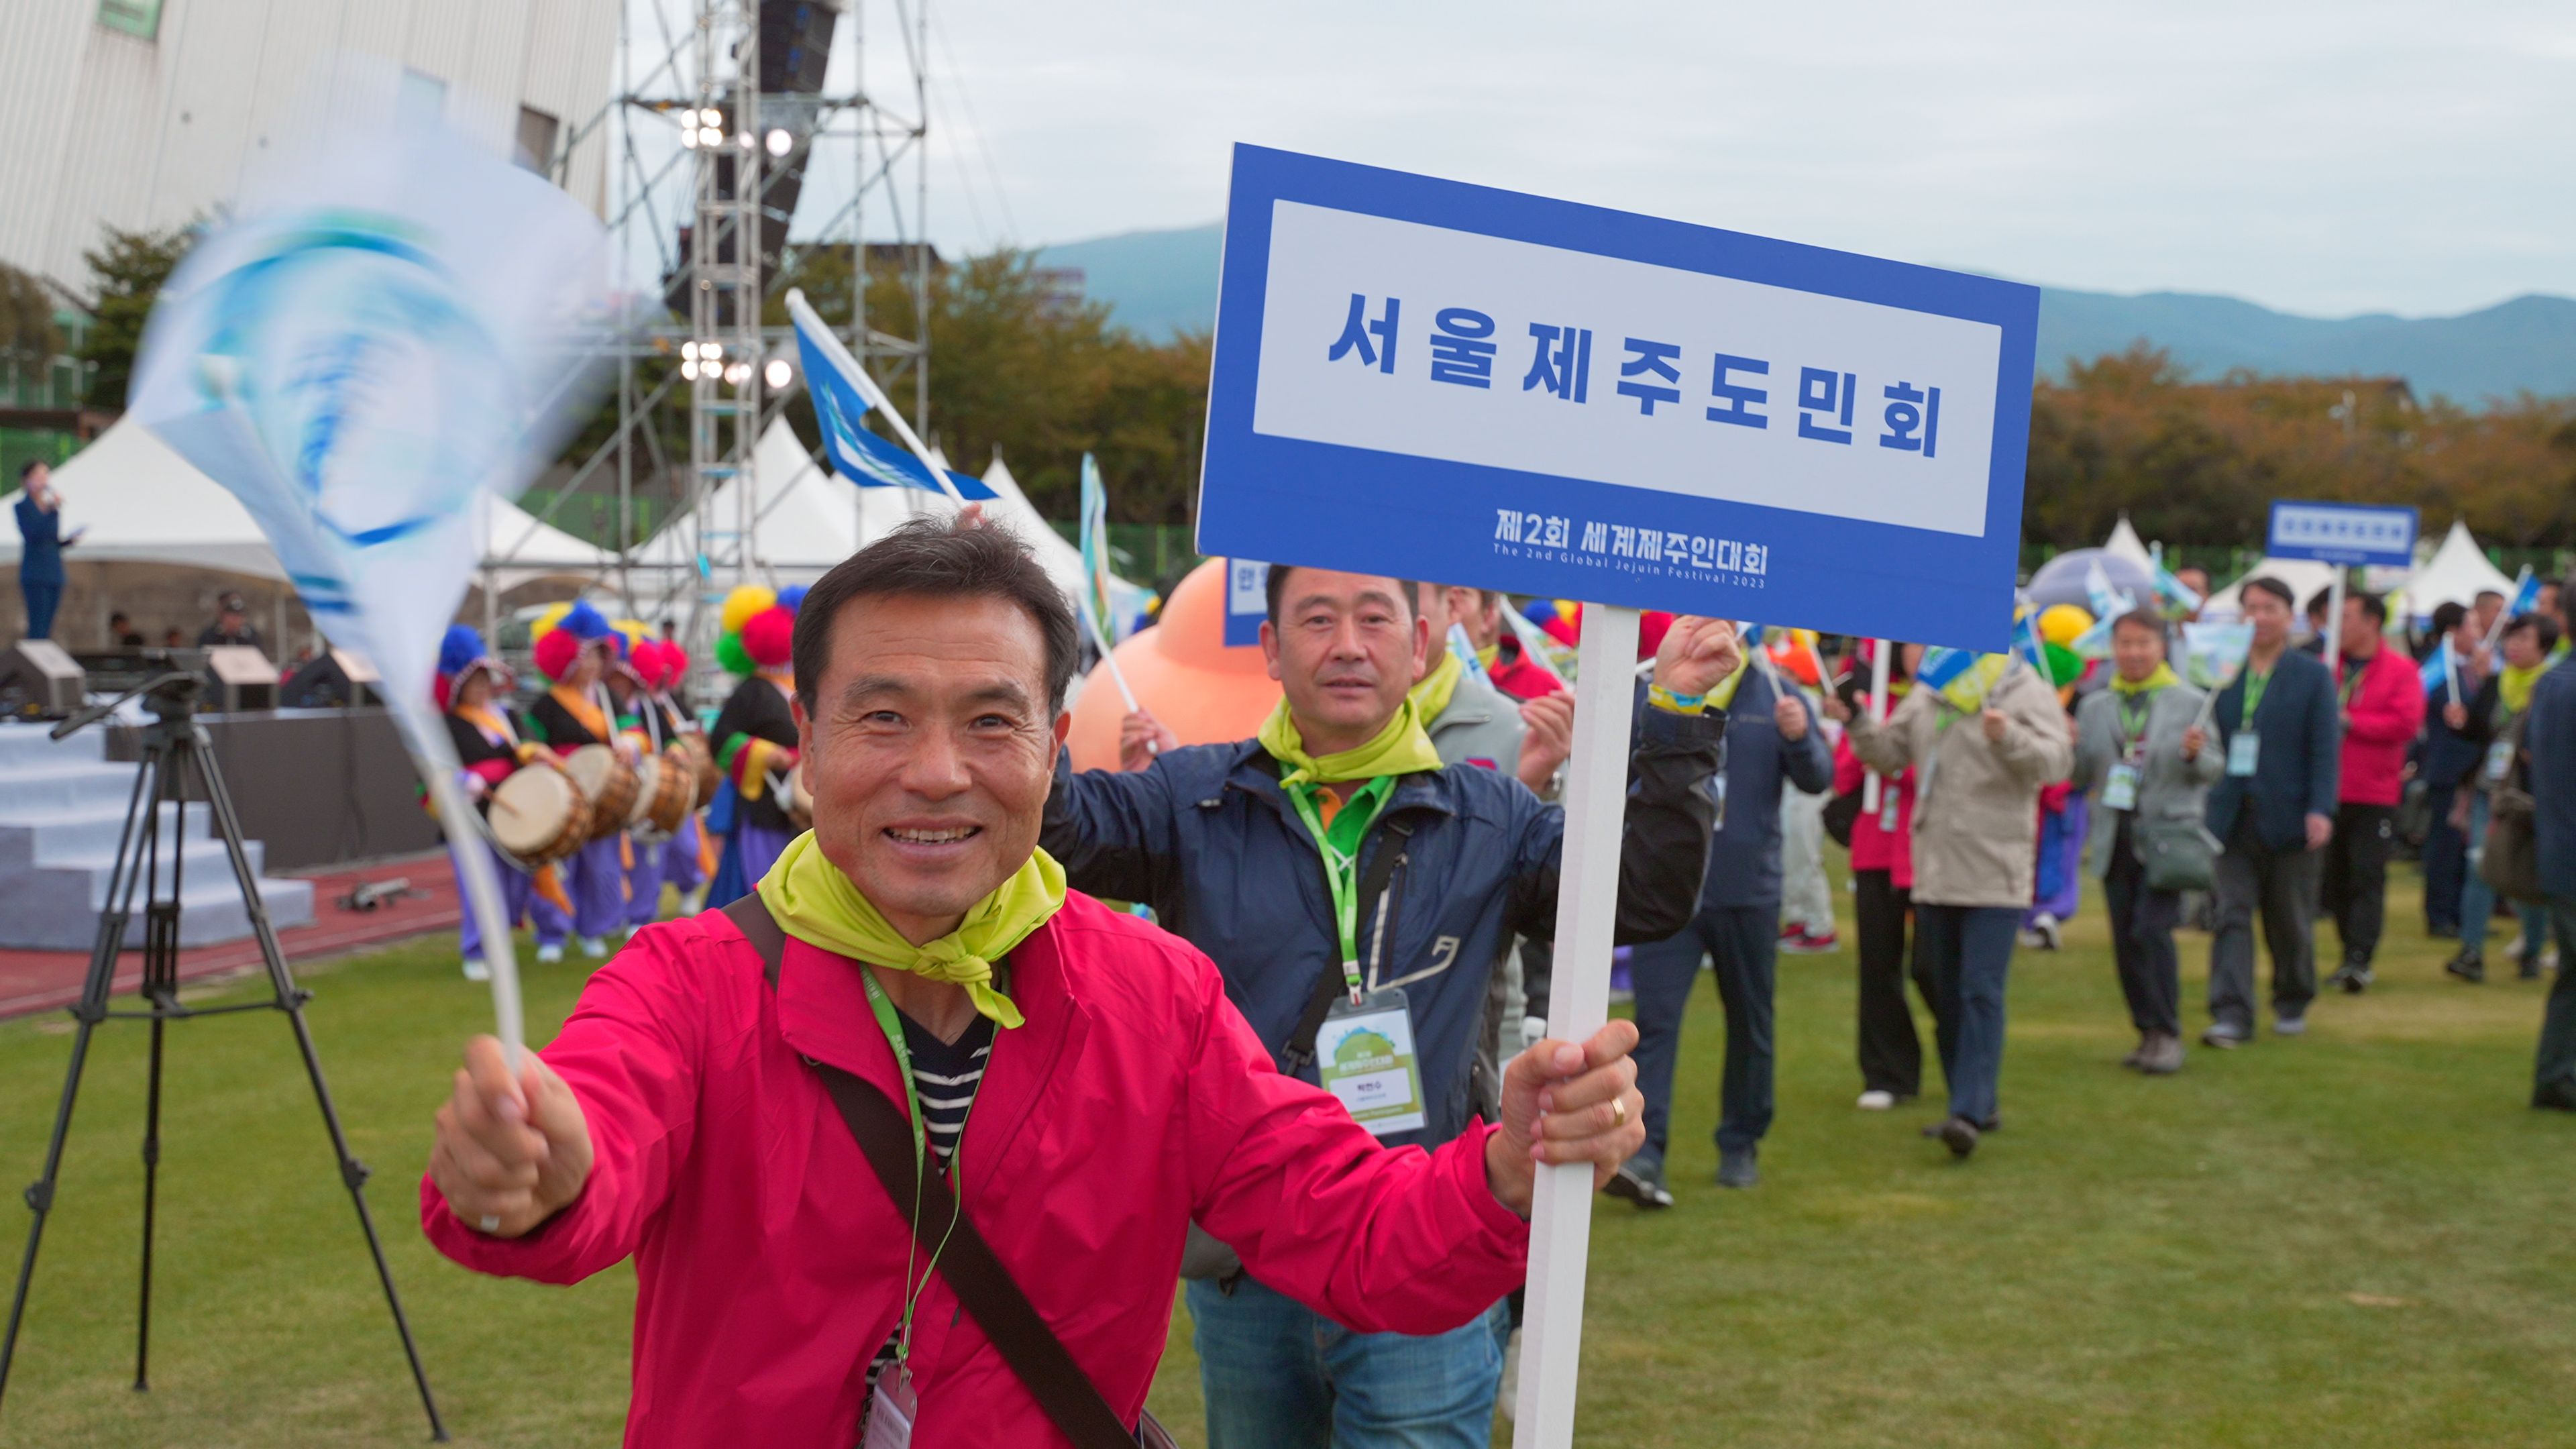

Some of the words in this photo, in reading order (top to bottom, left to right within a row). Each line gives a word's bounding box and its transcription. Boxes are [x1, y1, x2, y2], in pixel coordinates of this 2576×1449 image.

[1328, 292, 1941, 459] 서울제주도민회
[1493, 543, 1518, 557] The
[1526, 547, 1552, 561] 2nd
[1560, 552, 1608, 568] Global
[1615, 559, 1660, 574] Jejuin
[1668, 566, 1725, 584] Festival
[1733, 575, 1765, 589] 2023
[1495, 508, 1570, 549] 제2회
[1580, 521, 1768, 576] 세계제주인대회
